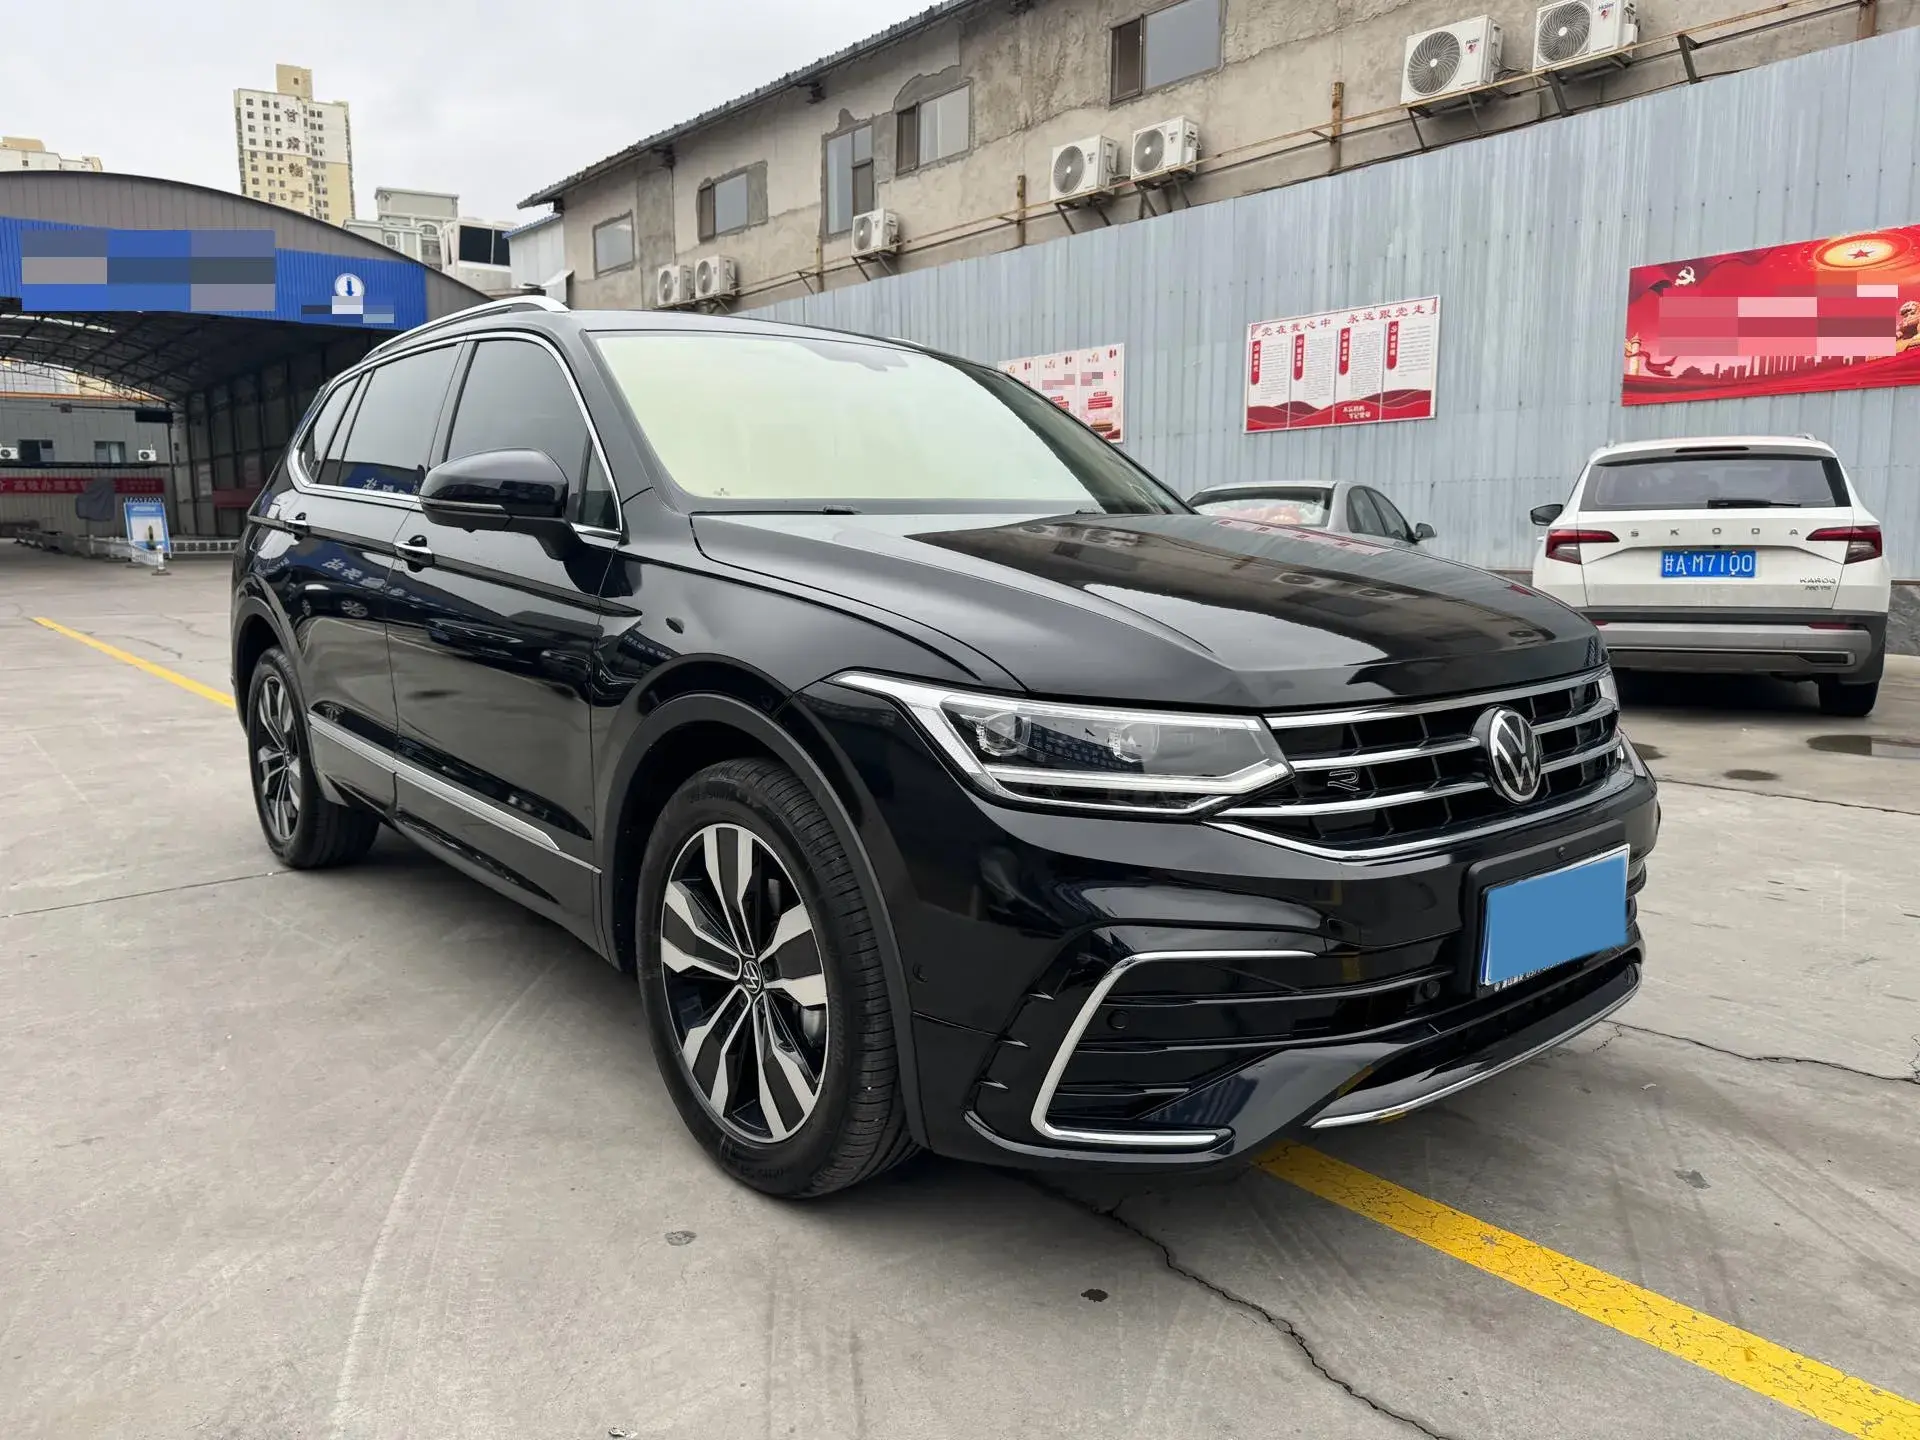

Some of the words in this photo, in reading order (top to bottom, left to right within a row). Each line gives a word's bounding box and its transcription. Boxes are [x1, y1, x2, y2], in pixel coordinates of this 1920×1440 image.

[1261, 317, 1332, 337] 党在我心中
[1347, 303, 1426, 325] 永远跟党走
[1630, 527, 1799, 537] SKODA
